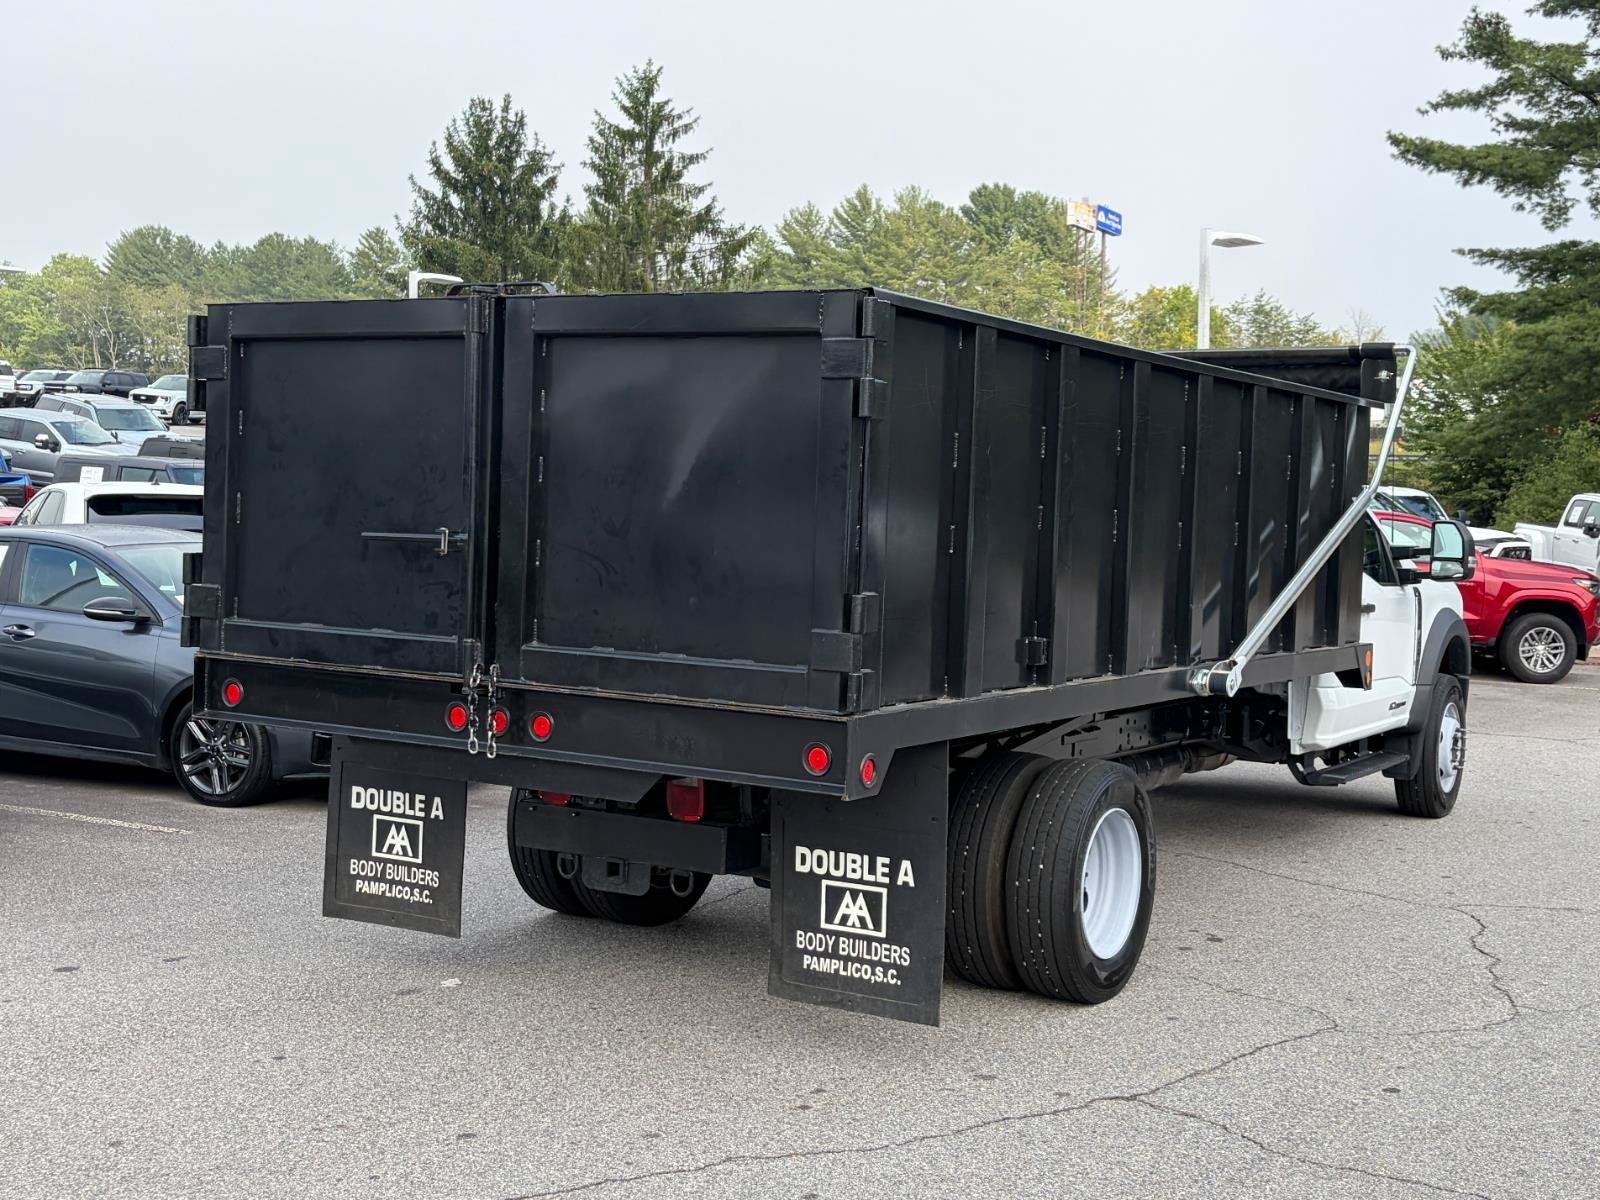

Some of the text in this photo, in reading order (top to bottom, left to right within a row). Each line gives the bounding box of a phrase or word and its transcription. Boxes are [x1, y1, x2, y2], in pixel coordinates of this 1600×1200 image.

[351, 785, 444, 820] DOUBLE A
[350, 859, 439, 888] BODY BUILDERS
[795, 845, 915, 887] DOUBLE A
[796, 930, 910, 966] BODY BUILDERS
